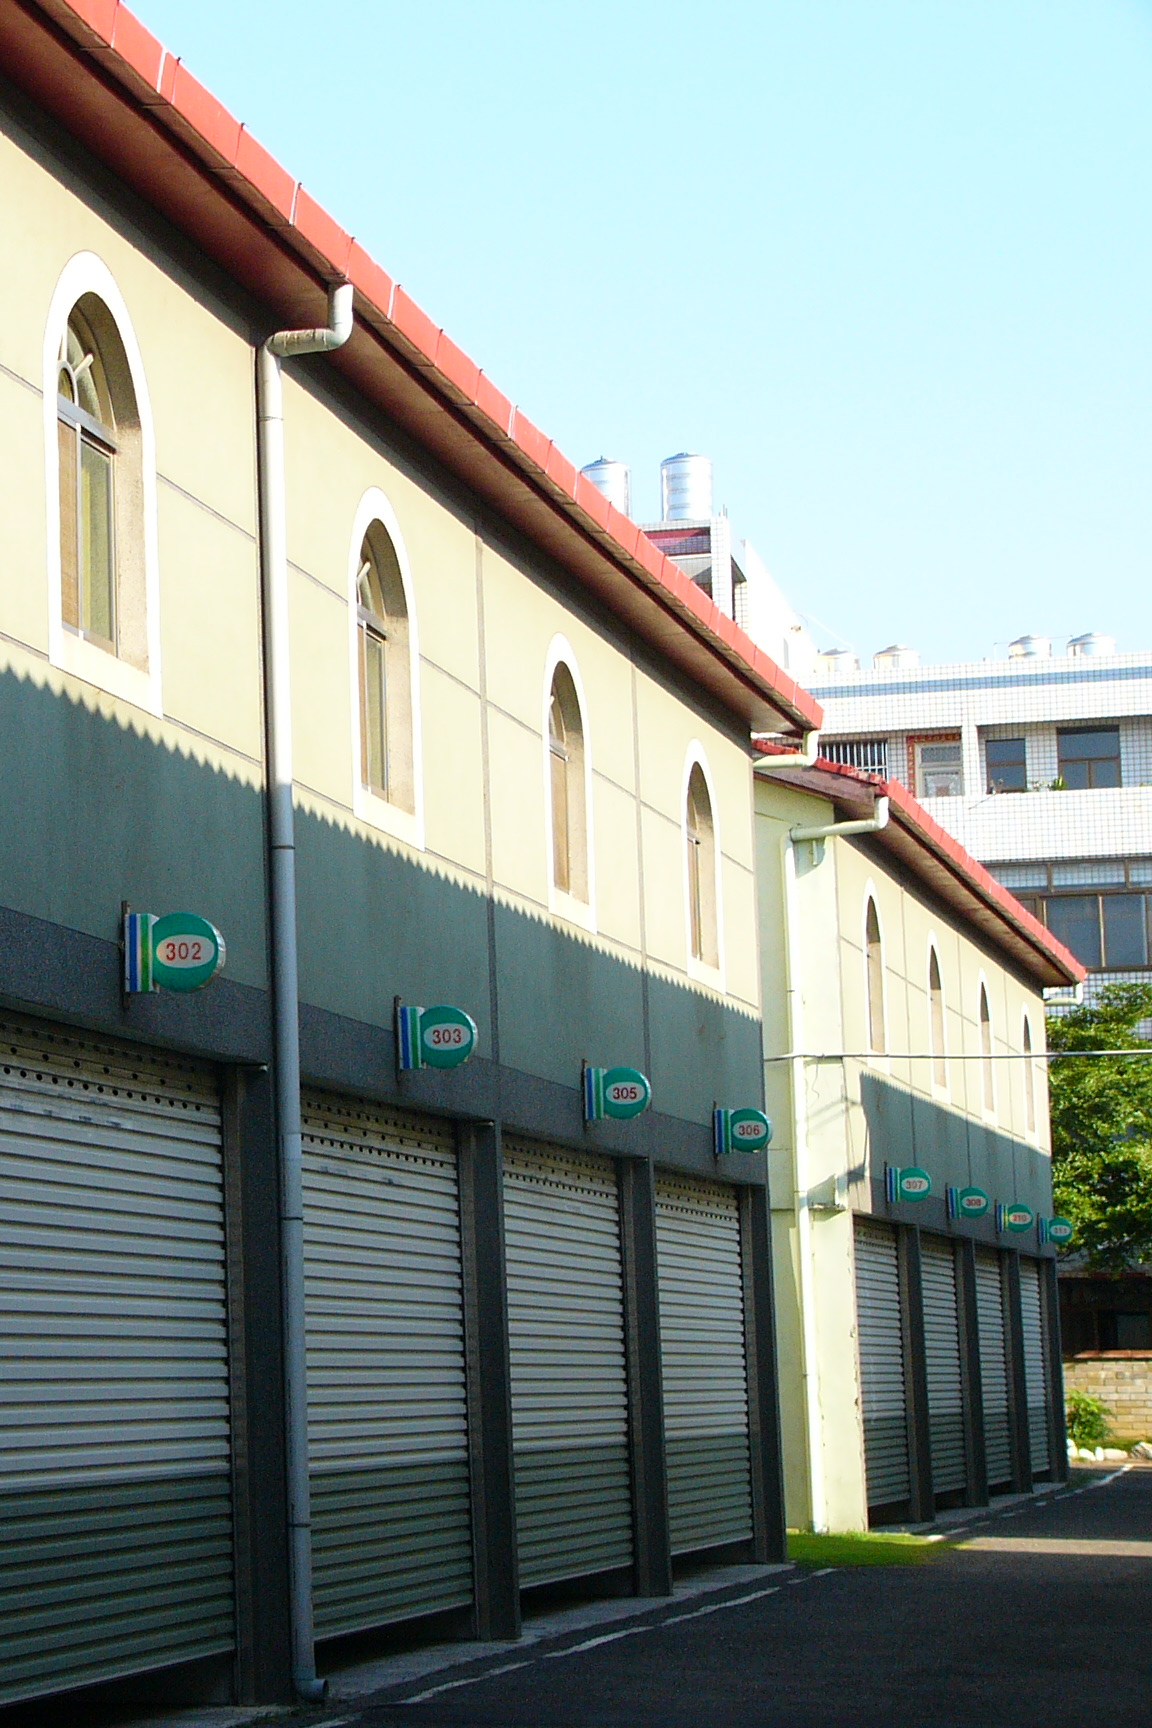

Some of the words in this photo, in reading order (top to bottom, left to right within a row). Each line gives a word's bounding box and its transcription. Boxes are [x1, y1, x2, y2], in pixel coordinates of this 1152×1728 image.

[166, 941, 202, 961] 302
[432, 1028, 462, 1045] 303
[612, 1086, 638, 1100] 305
[738, 1124, 760, 1137] 306
[905, 1180, 923, 1190] 307
